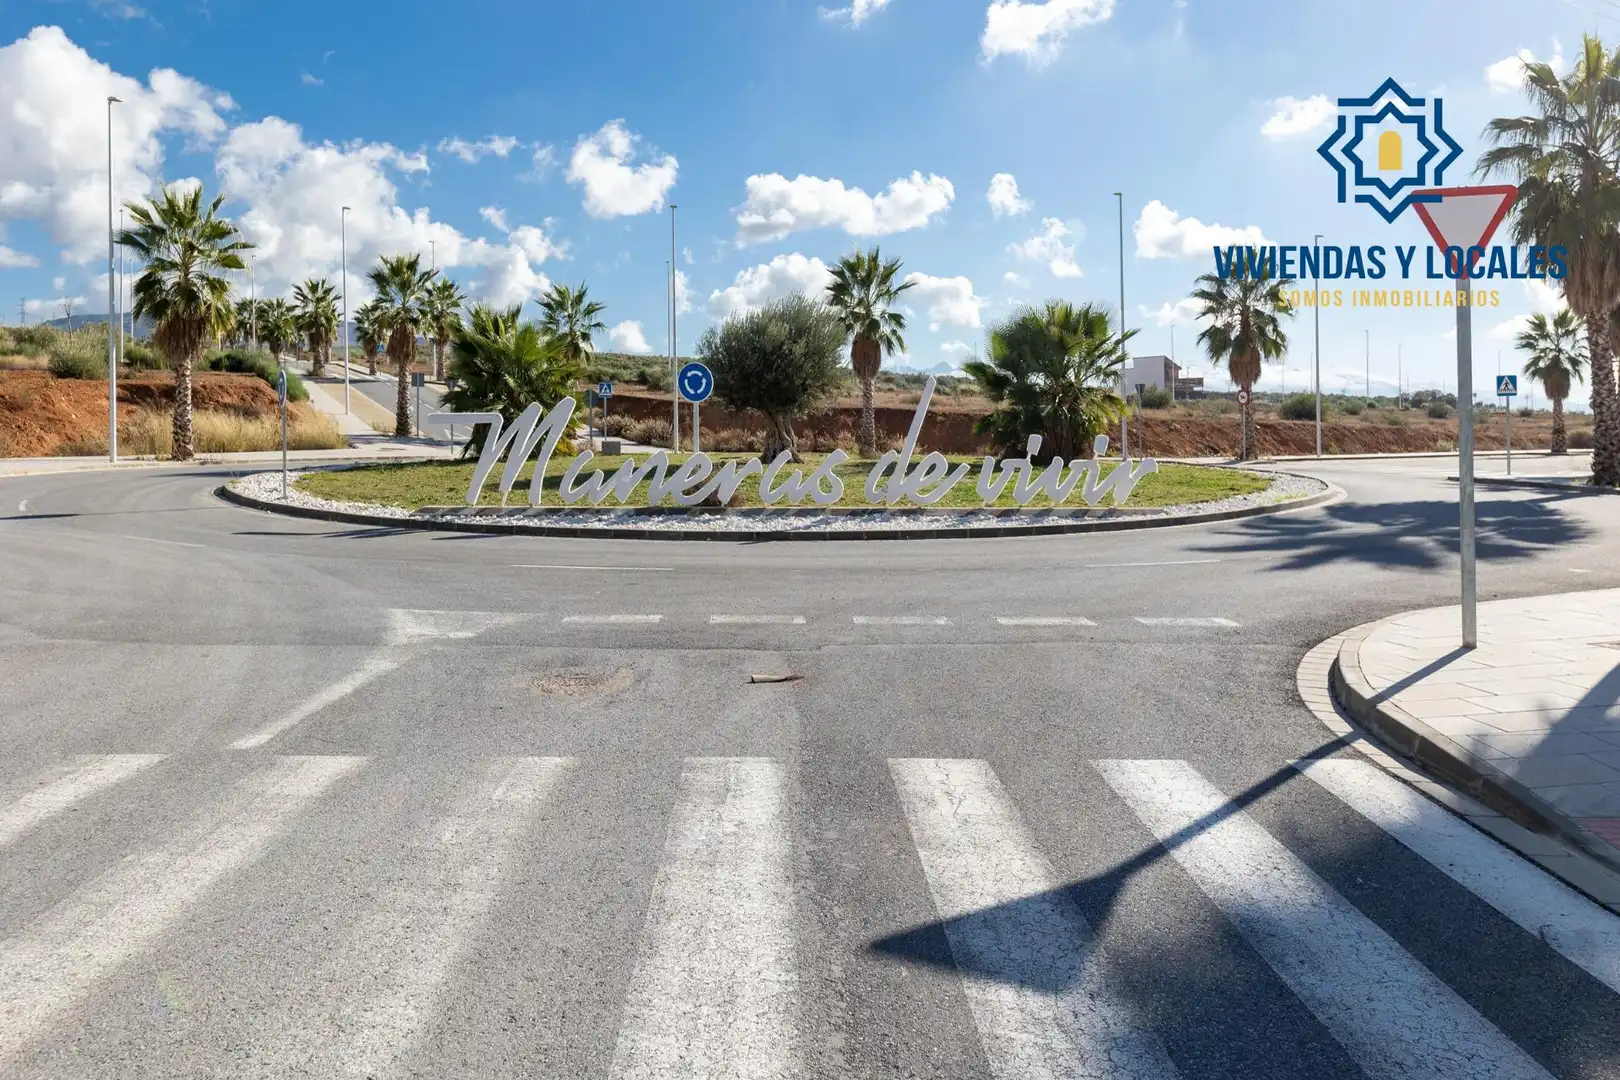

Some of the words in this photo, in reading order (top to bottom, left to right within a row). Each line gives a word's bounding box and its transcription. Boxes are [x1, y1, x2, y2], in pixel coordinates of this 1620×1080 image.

[428, 396, 850, 507] Maneras
[864, 375, 970, 506] de
[974, 434, 1159, 506] vivir
